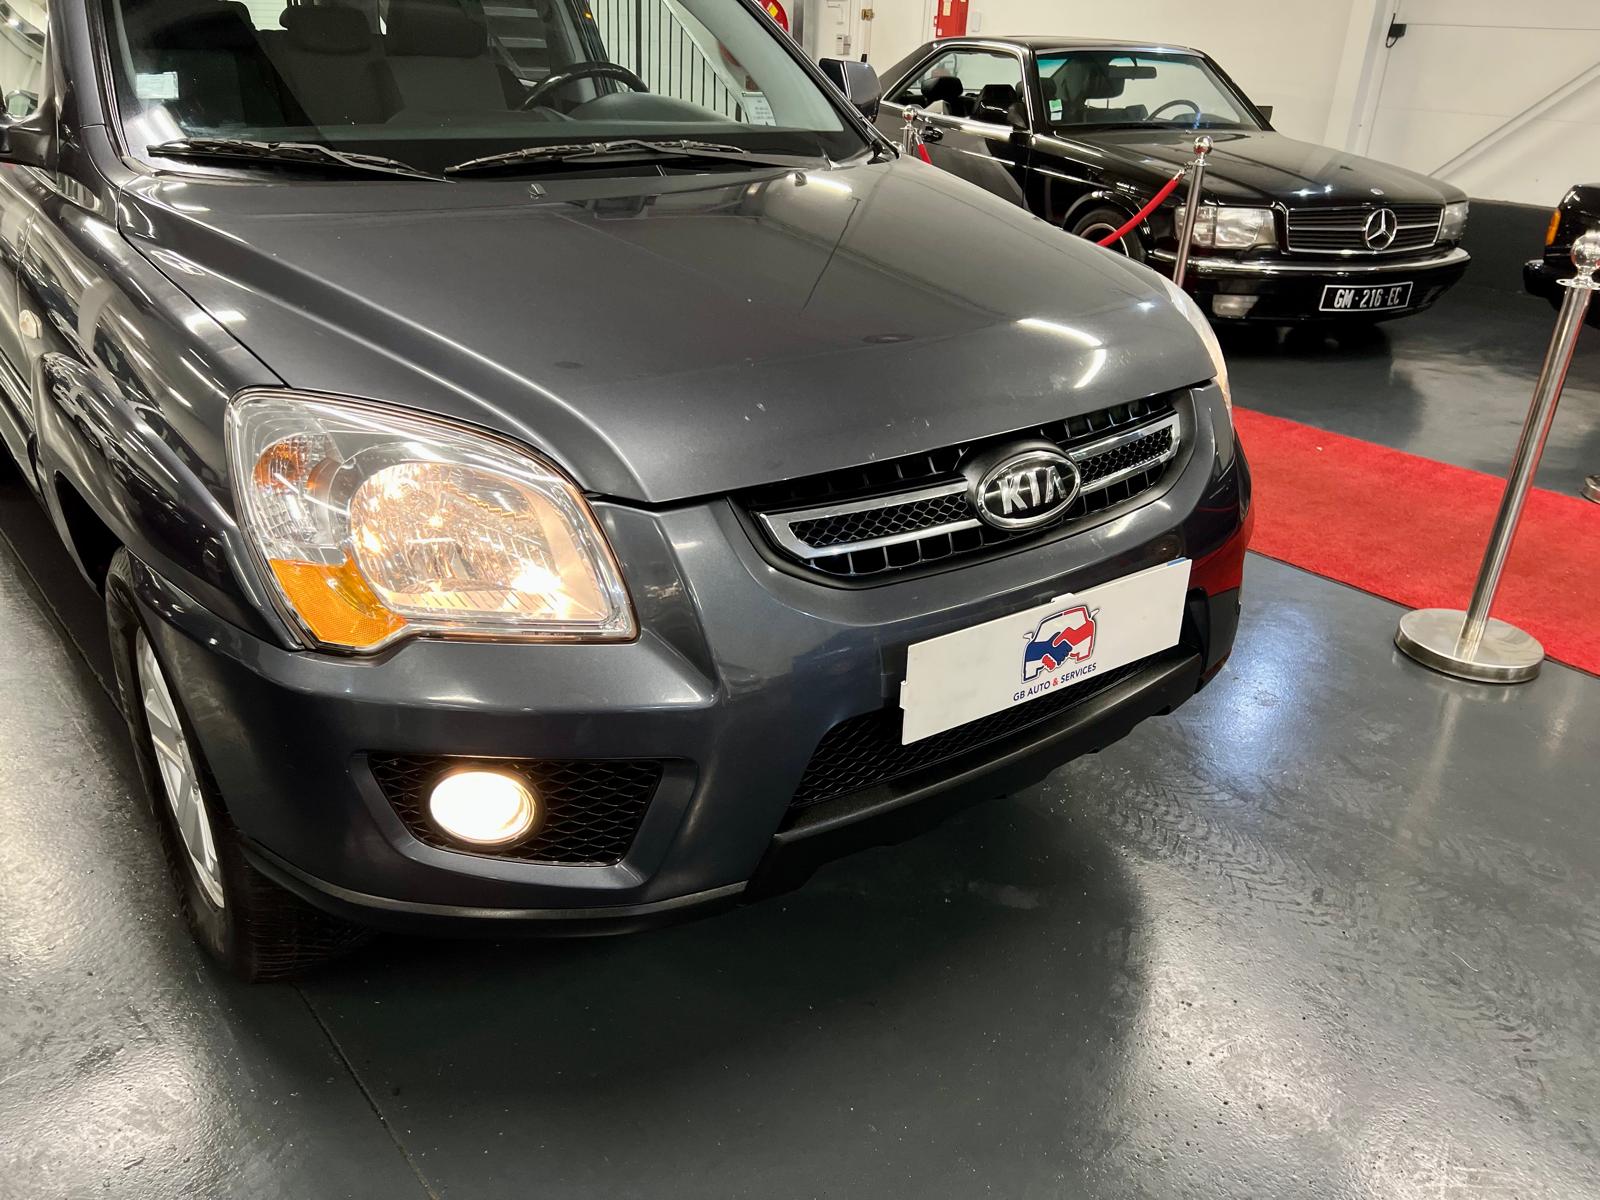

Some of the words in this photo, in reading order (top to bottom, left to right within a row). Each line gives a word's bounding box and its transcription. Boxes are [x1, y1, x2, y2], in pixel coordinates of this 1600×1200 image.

[997, 465, 1067, 514] KIA
[1013, 690, 1025, 701] GB
[1027, 680, 1050, 696] AUTO
[1052, 677, 1059, 686] &
[1060, 662, 1096, 683] SERVICES
